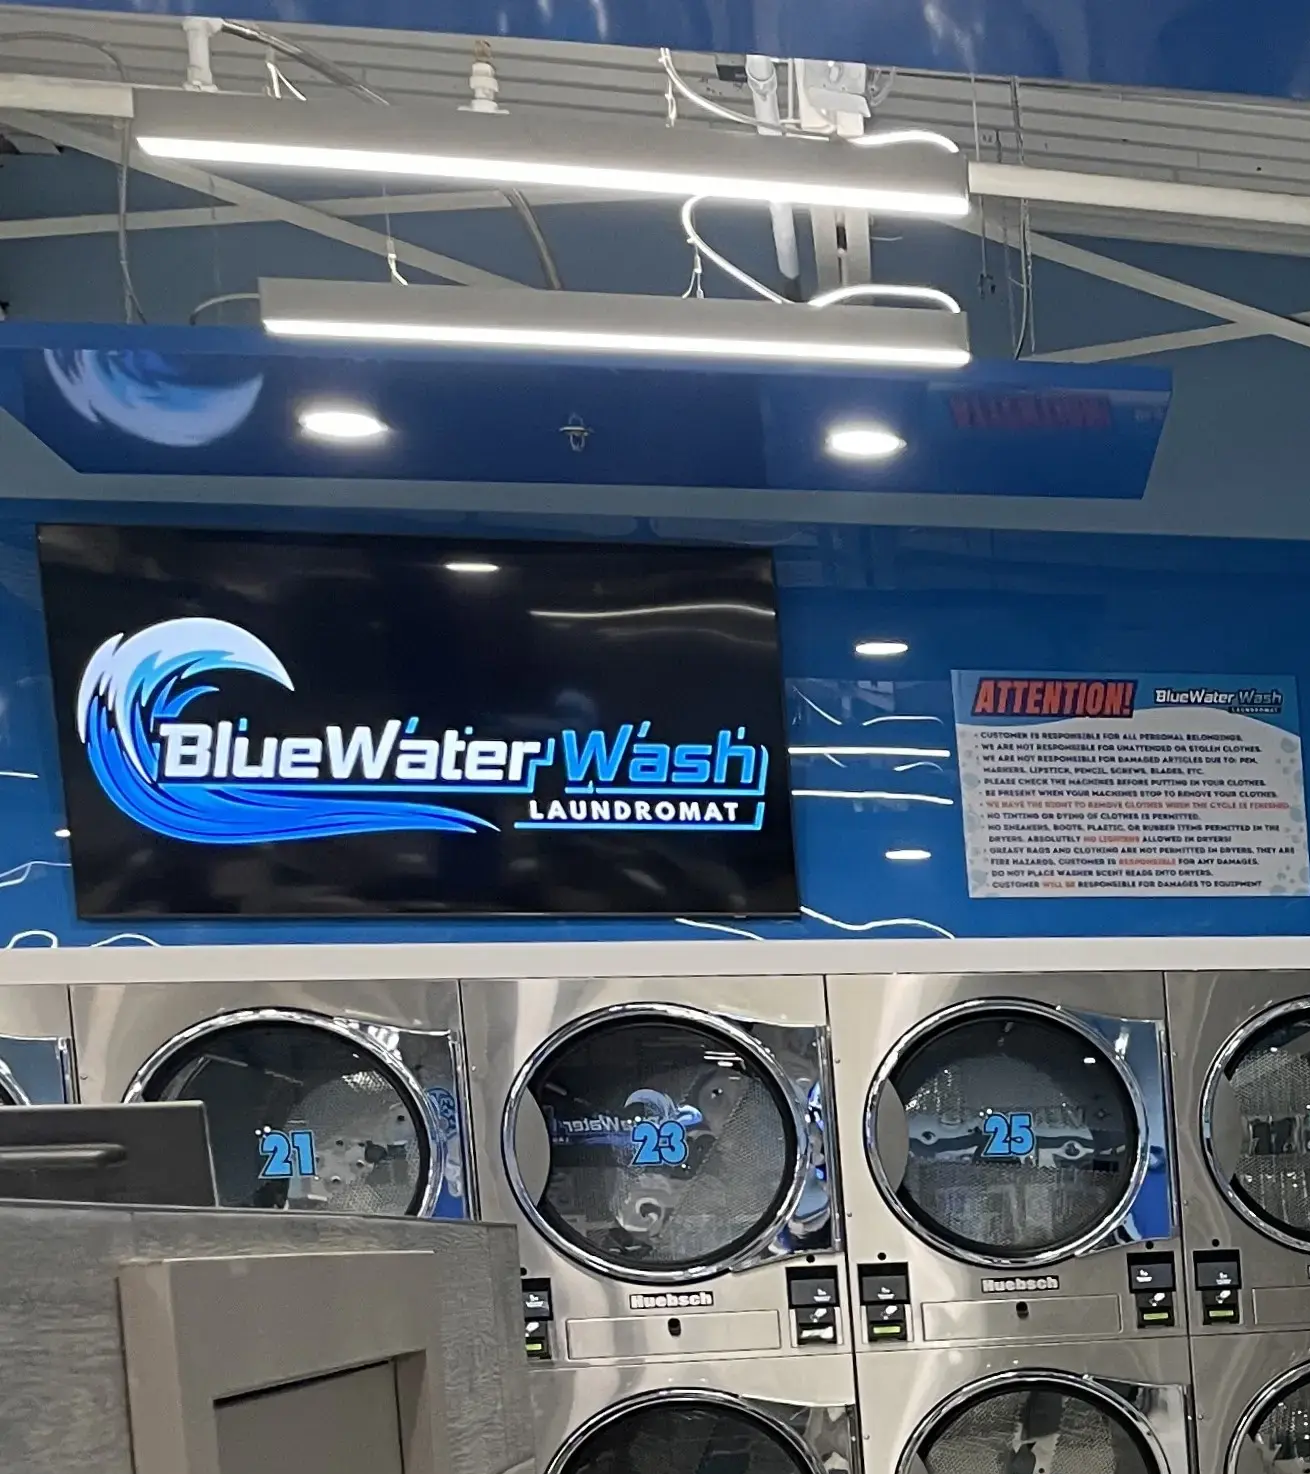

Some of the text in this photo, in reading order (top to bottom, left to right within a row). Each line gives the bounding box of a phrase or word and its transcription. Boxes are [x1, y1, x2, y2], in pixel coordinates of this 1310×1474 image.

[974, 680, 1134, 715] ATTENTION!
[1156, 689, 1283, 704] BlueWater Wash
[160, 719, 756, 783] BlueWater Wash
[529, 800, 739, 822] LAUNDROMAT
[632, 1112, 697, 1164] 23
[984, 1114, 1034, 1155] 25
[261, 1132, 314, 1176] 21
[631, 1292, 712, 1309] Huebsch
[982, 1276, 1058, 1293] Huebsch
